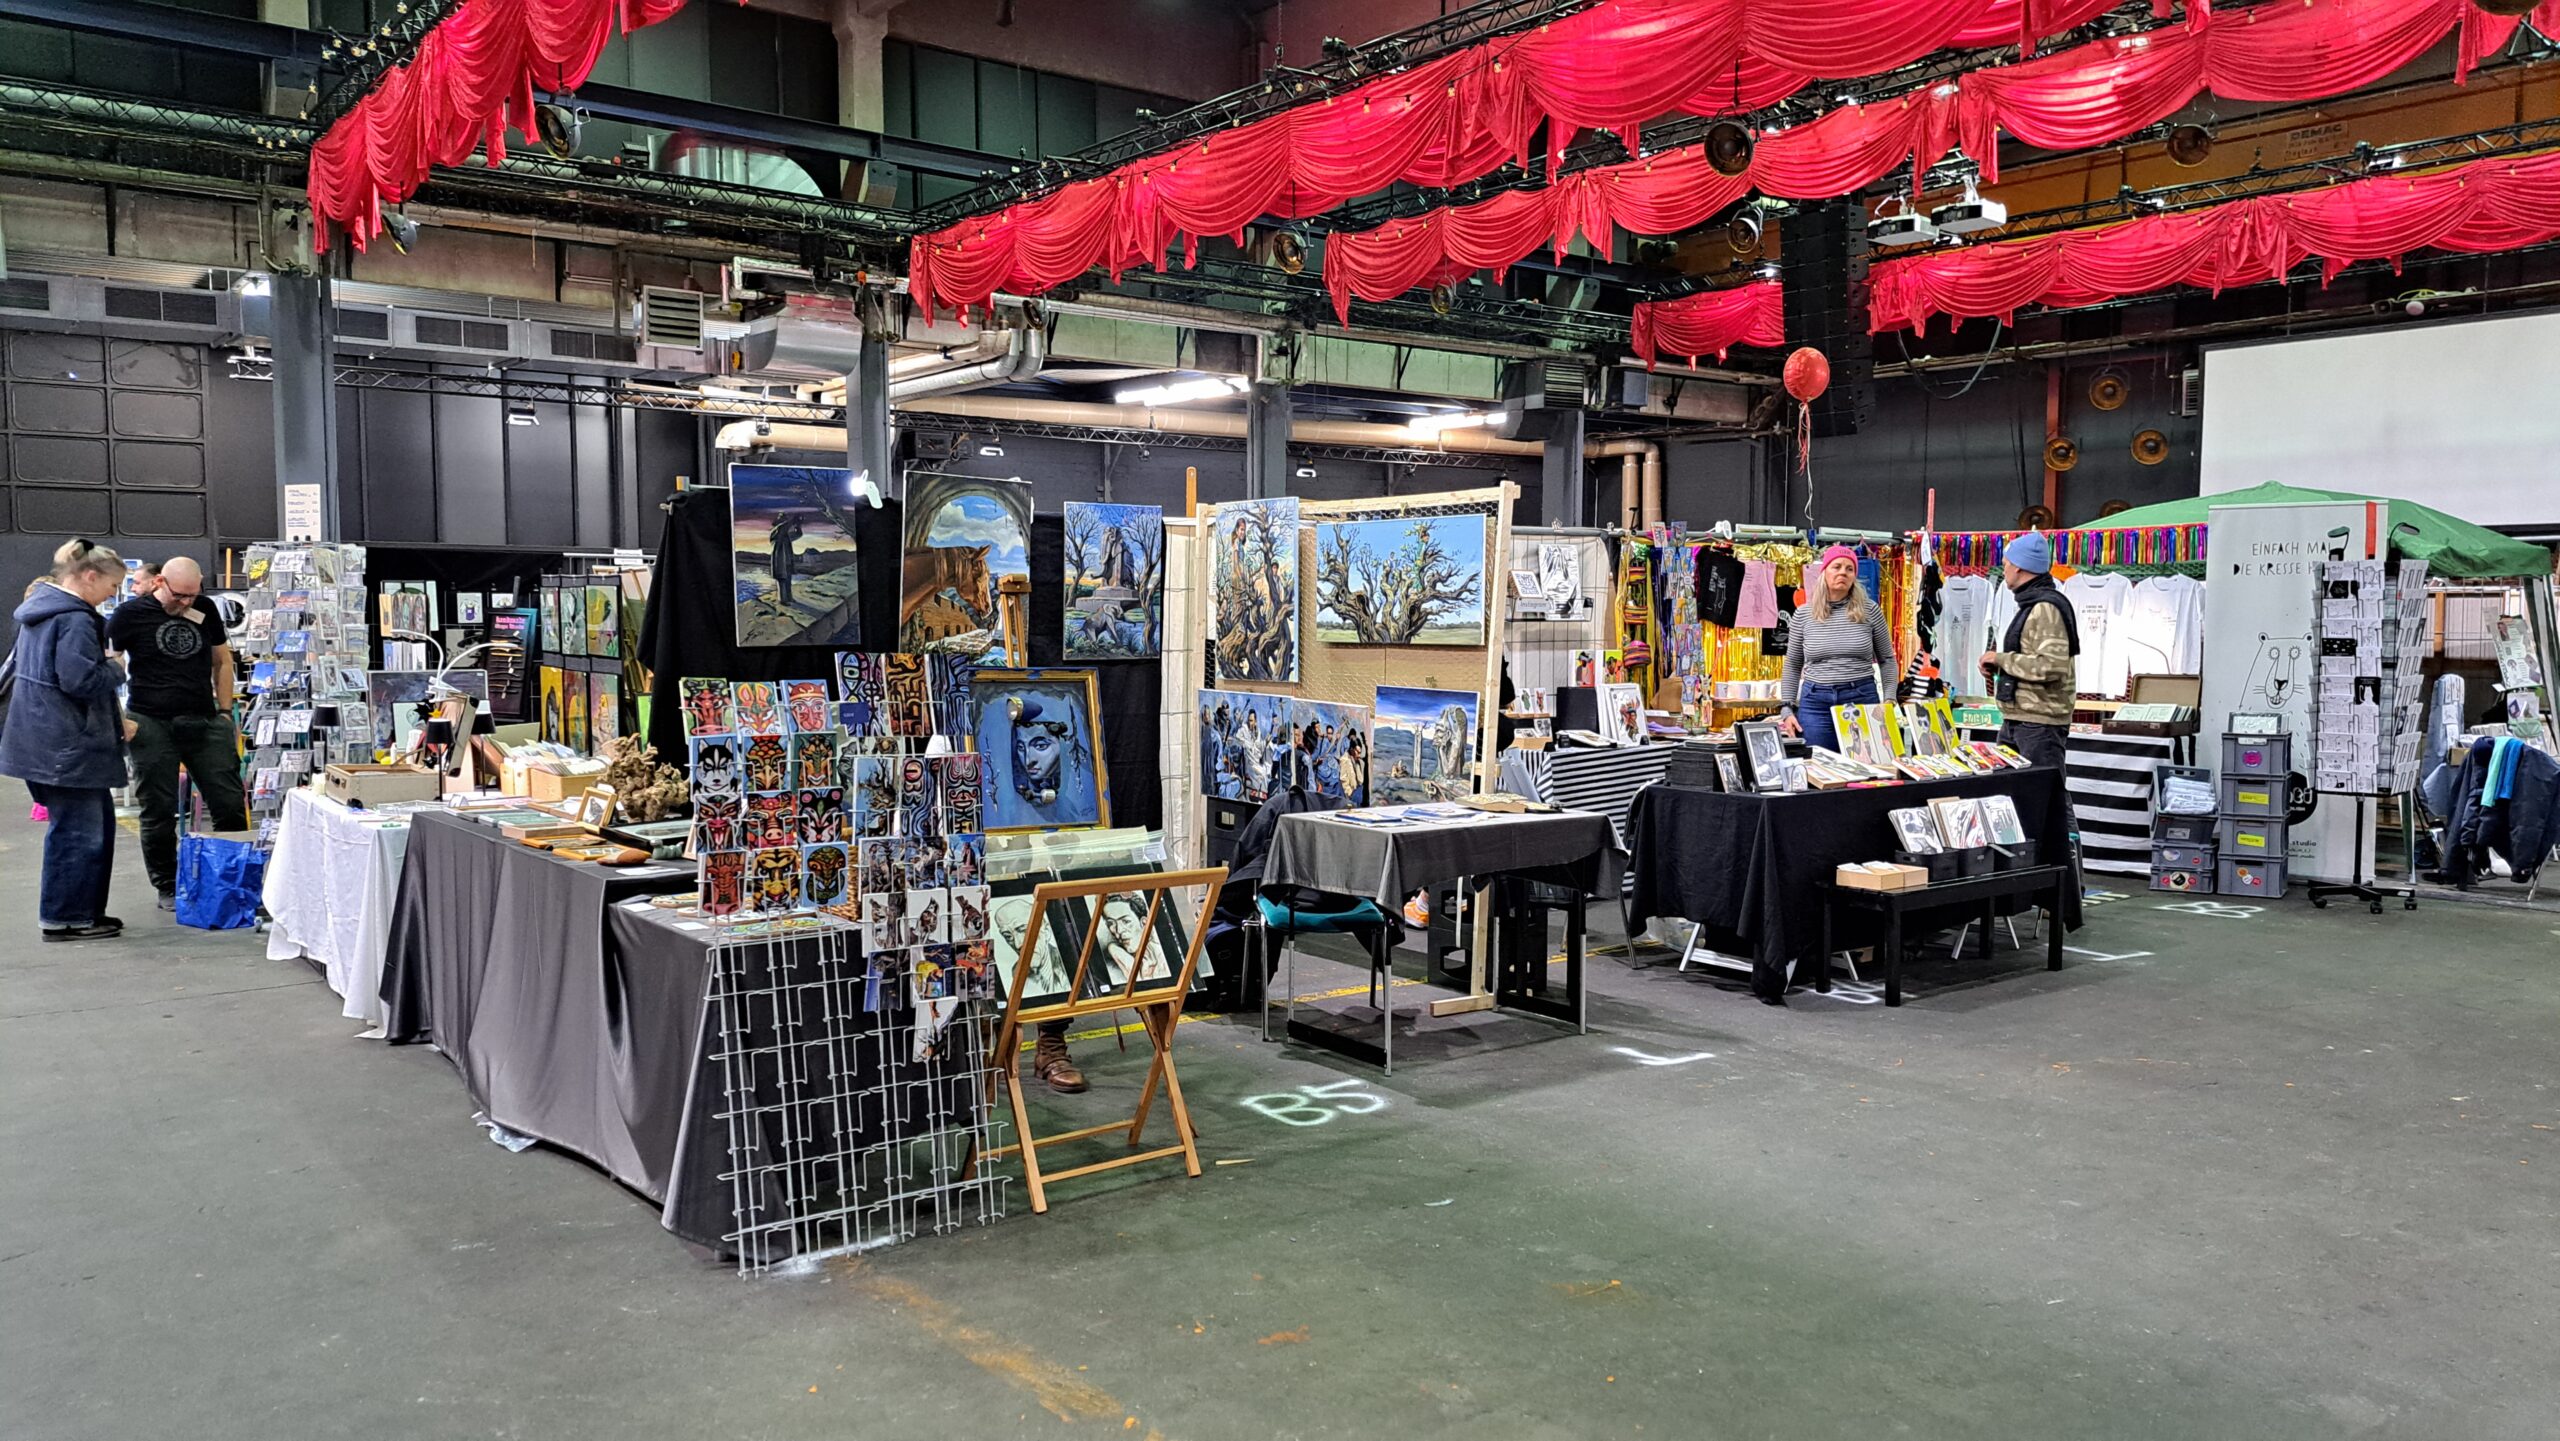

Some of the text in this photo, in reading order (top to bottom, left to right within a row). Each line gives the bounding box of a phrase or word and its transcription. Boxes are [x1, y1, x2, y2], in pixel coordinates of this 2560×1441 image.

[2252, 541, 2299, 556] EINFACH
[2233, 563, 2252, 576] DIE
[2259, 562, 2302, 576] KRESSE
[1240, 1079, 1385, 1126] B5
